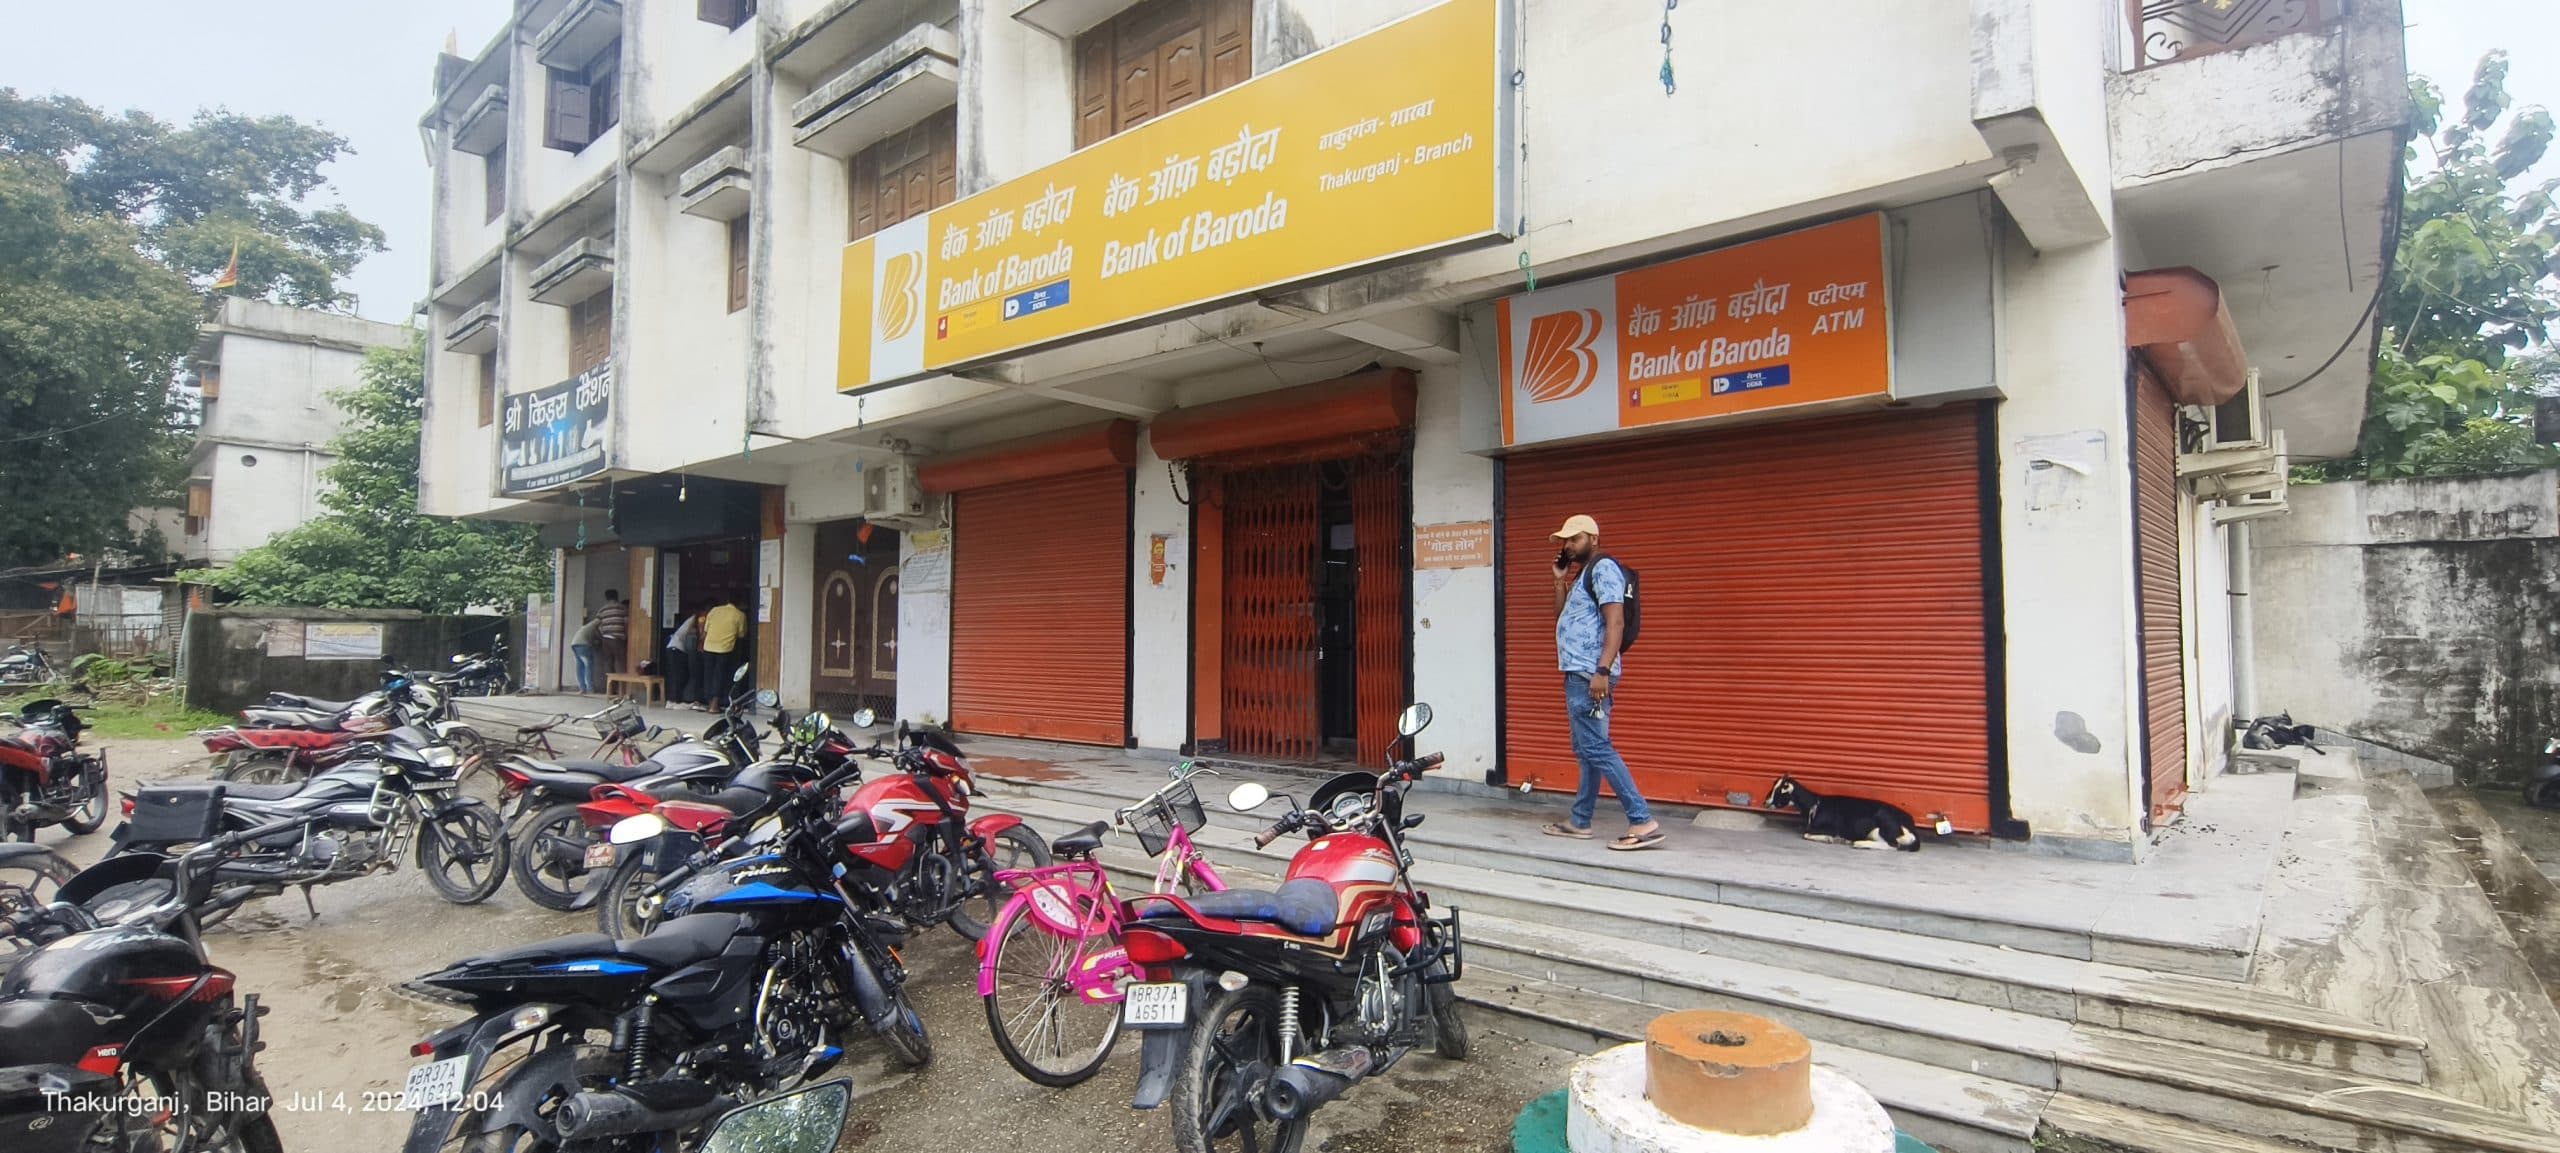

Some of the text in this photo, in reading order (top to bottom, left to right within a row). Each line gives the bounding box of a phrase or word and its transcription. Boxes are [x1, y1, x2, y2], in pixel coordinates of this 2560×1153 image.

[1103, 173, 1139, 218] बैंक
[1206, 124, 1281, 187] बड़ौदा
[1319, 153, 1401, 192] Thakurganj
[1414, 133, 1473, 165] Branch
[941, 223, 968, 261] बैंक
[1022, 183, 1077, 237] बड़ौदा
[1100, 192, 1288, 279] Bank of Baroda
[938, 240, 1073, 311] Bank of Baroda
[1807, 281, 1868, 307] एटीएम
[1627, 303, 1662, 338] बैंक
[1728, 278, 1790, 324] बड़ौदा
[1811, 308, 1865, 335] ATM
[1628, 328, 1790, 381] Bank of Baroda
[505, 398, 522, 434] श्री
[1135, 1004, 1175, 1020] A6511
[1136, 986, 1177, 1002] BR37A
[415, 1062, 457, 1085] BR37A
